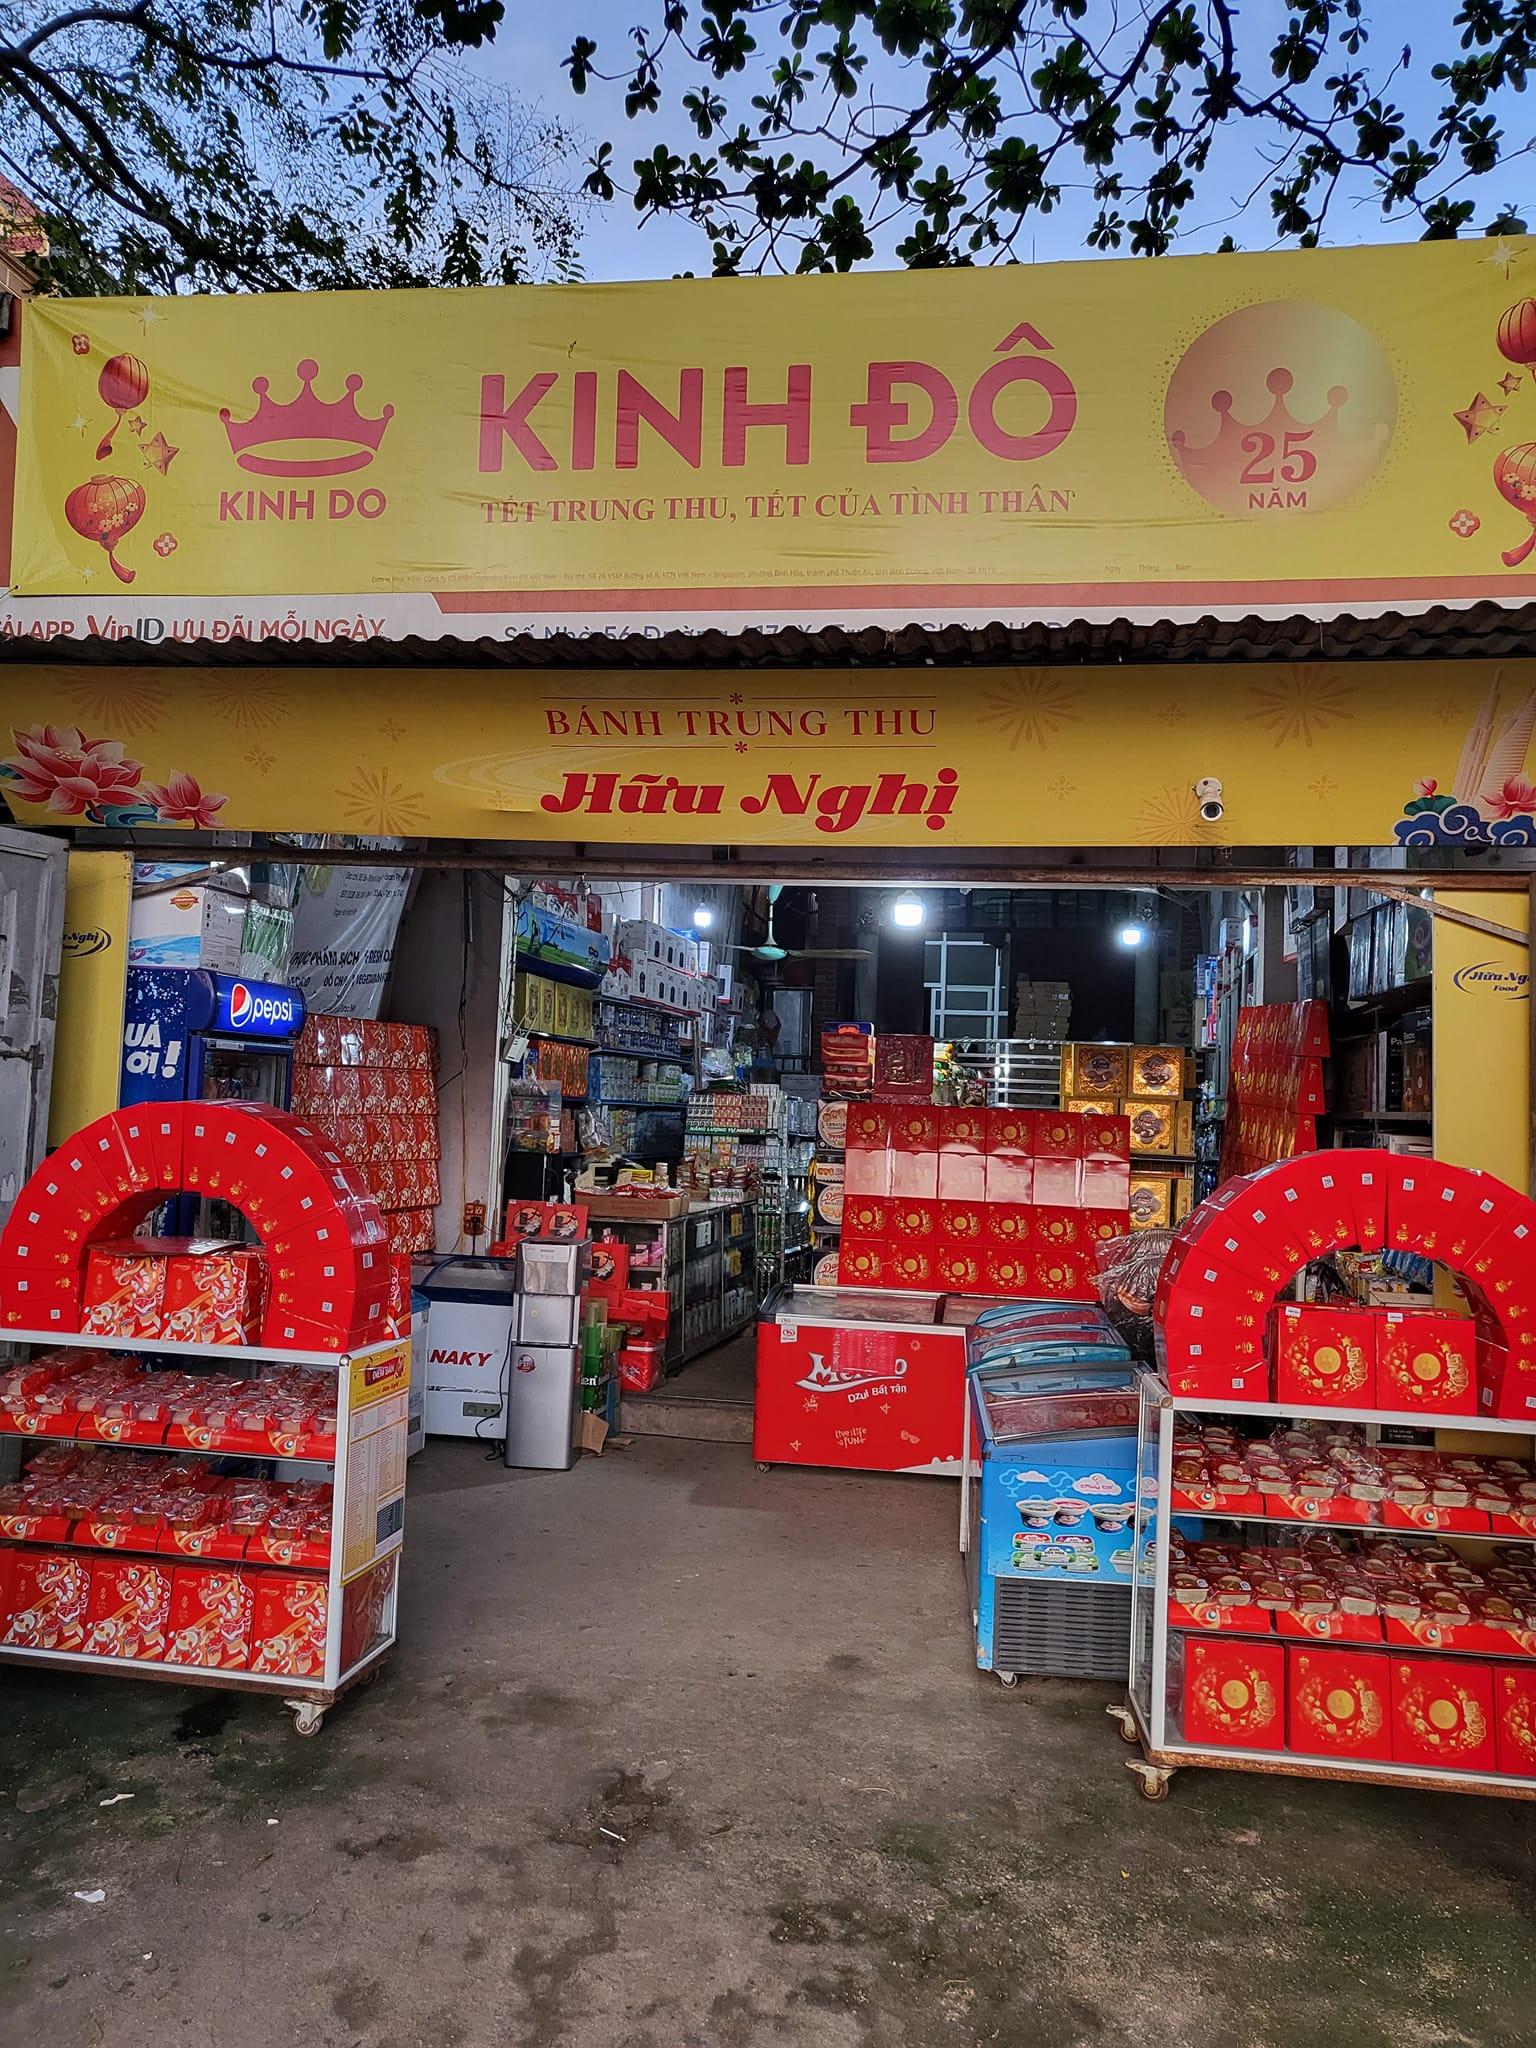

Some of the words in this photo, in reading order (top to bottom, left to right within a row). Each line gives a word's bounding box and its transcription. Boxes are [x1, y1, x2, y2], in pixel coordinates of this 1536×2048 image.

[478, 364, 811, 473] KINH
[850, 321, 1078, 464] ĐÔ
[1239, 429, 1317, 485] 25
[219, 489, 315, 522] KINH
[329, 488, 388, 520] DO
[481, 494, 539, 524] TẾT
[547, 499, 655, 523] TRUNG
[663, 495, 737, 524] THU,
[745, 488, 806, 519] TẾT
[815, 487, 881, 518] CỦA
[889, 486, 969, 516] TÌNH
[1247, 486, 1308, 511] NĂM
[87, 614, 164, 642] VinID
[172, 618, 205, 641] ƯU
[211, 614, 251, 641] ĐÃI
[259, 609, 306, 641] MỖI
[314, 613, 386, 640] NGÀY
[545, 704, 663, 737] BÁNH
[677, 707, 828, 737] TRUNG
[843, 708, 938, 736] THU
[541, 771, 724, 815] Hữu
[741, 767, 961, 834] Nghị
[251, 998, 294, 1025] pepsi
[427, 1348, 493, 1367] NAKY
